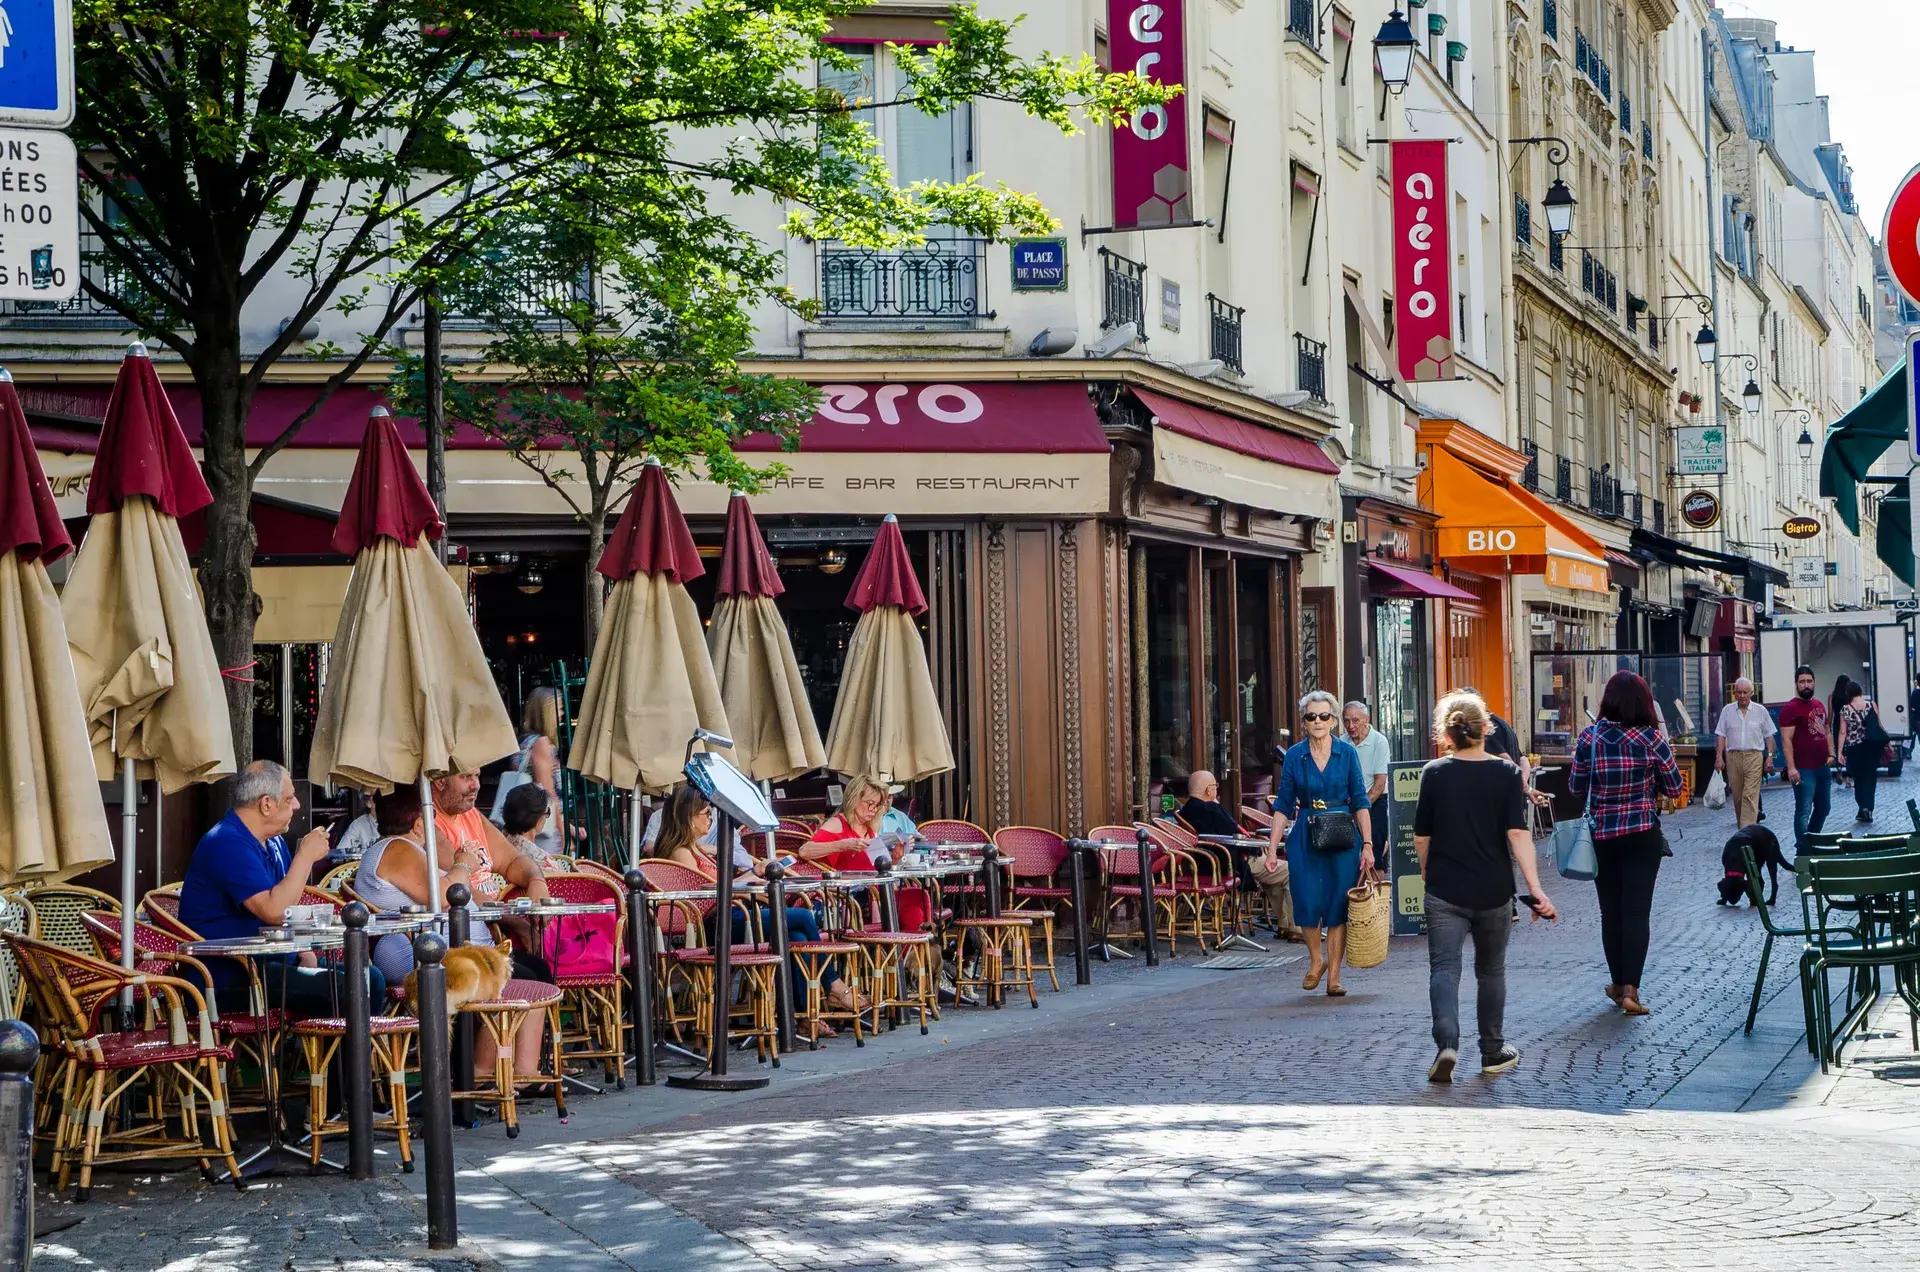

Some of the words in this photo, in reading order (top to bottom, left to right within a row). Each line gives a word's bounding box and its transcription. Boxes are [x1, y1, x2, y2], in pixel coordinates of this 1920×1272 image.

[0, 140, 40, 162] NS
[2, 167, 47, 193] ÉES
[1023, 251, 1054, 263] PLACE
[1017, 267, 1030, 279] DE
[1032, 267, 1062, 279] PASSY
[1688, 464, 1718, 472] ITALIEN
[760, 476, 825, 489] CAFE
[846, 477, 896, 489] BAR
[916, 477, 1080, 490] RESTAURANT
[1786, 522, 1818, 533] Bistrot
[1468, 529, 1516, 551] BIO
[1803, 562, 1814, 571] CLUB
[1798, 573, 1819, 582] PRESSING
[1405, 896, 1418, 904] 01
[1405, 905, 1420, 913] 06
